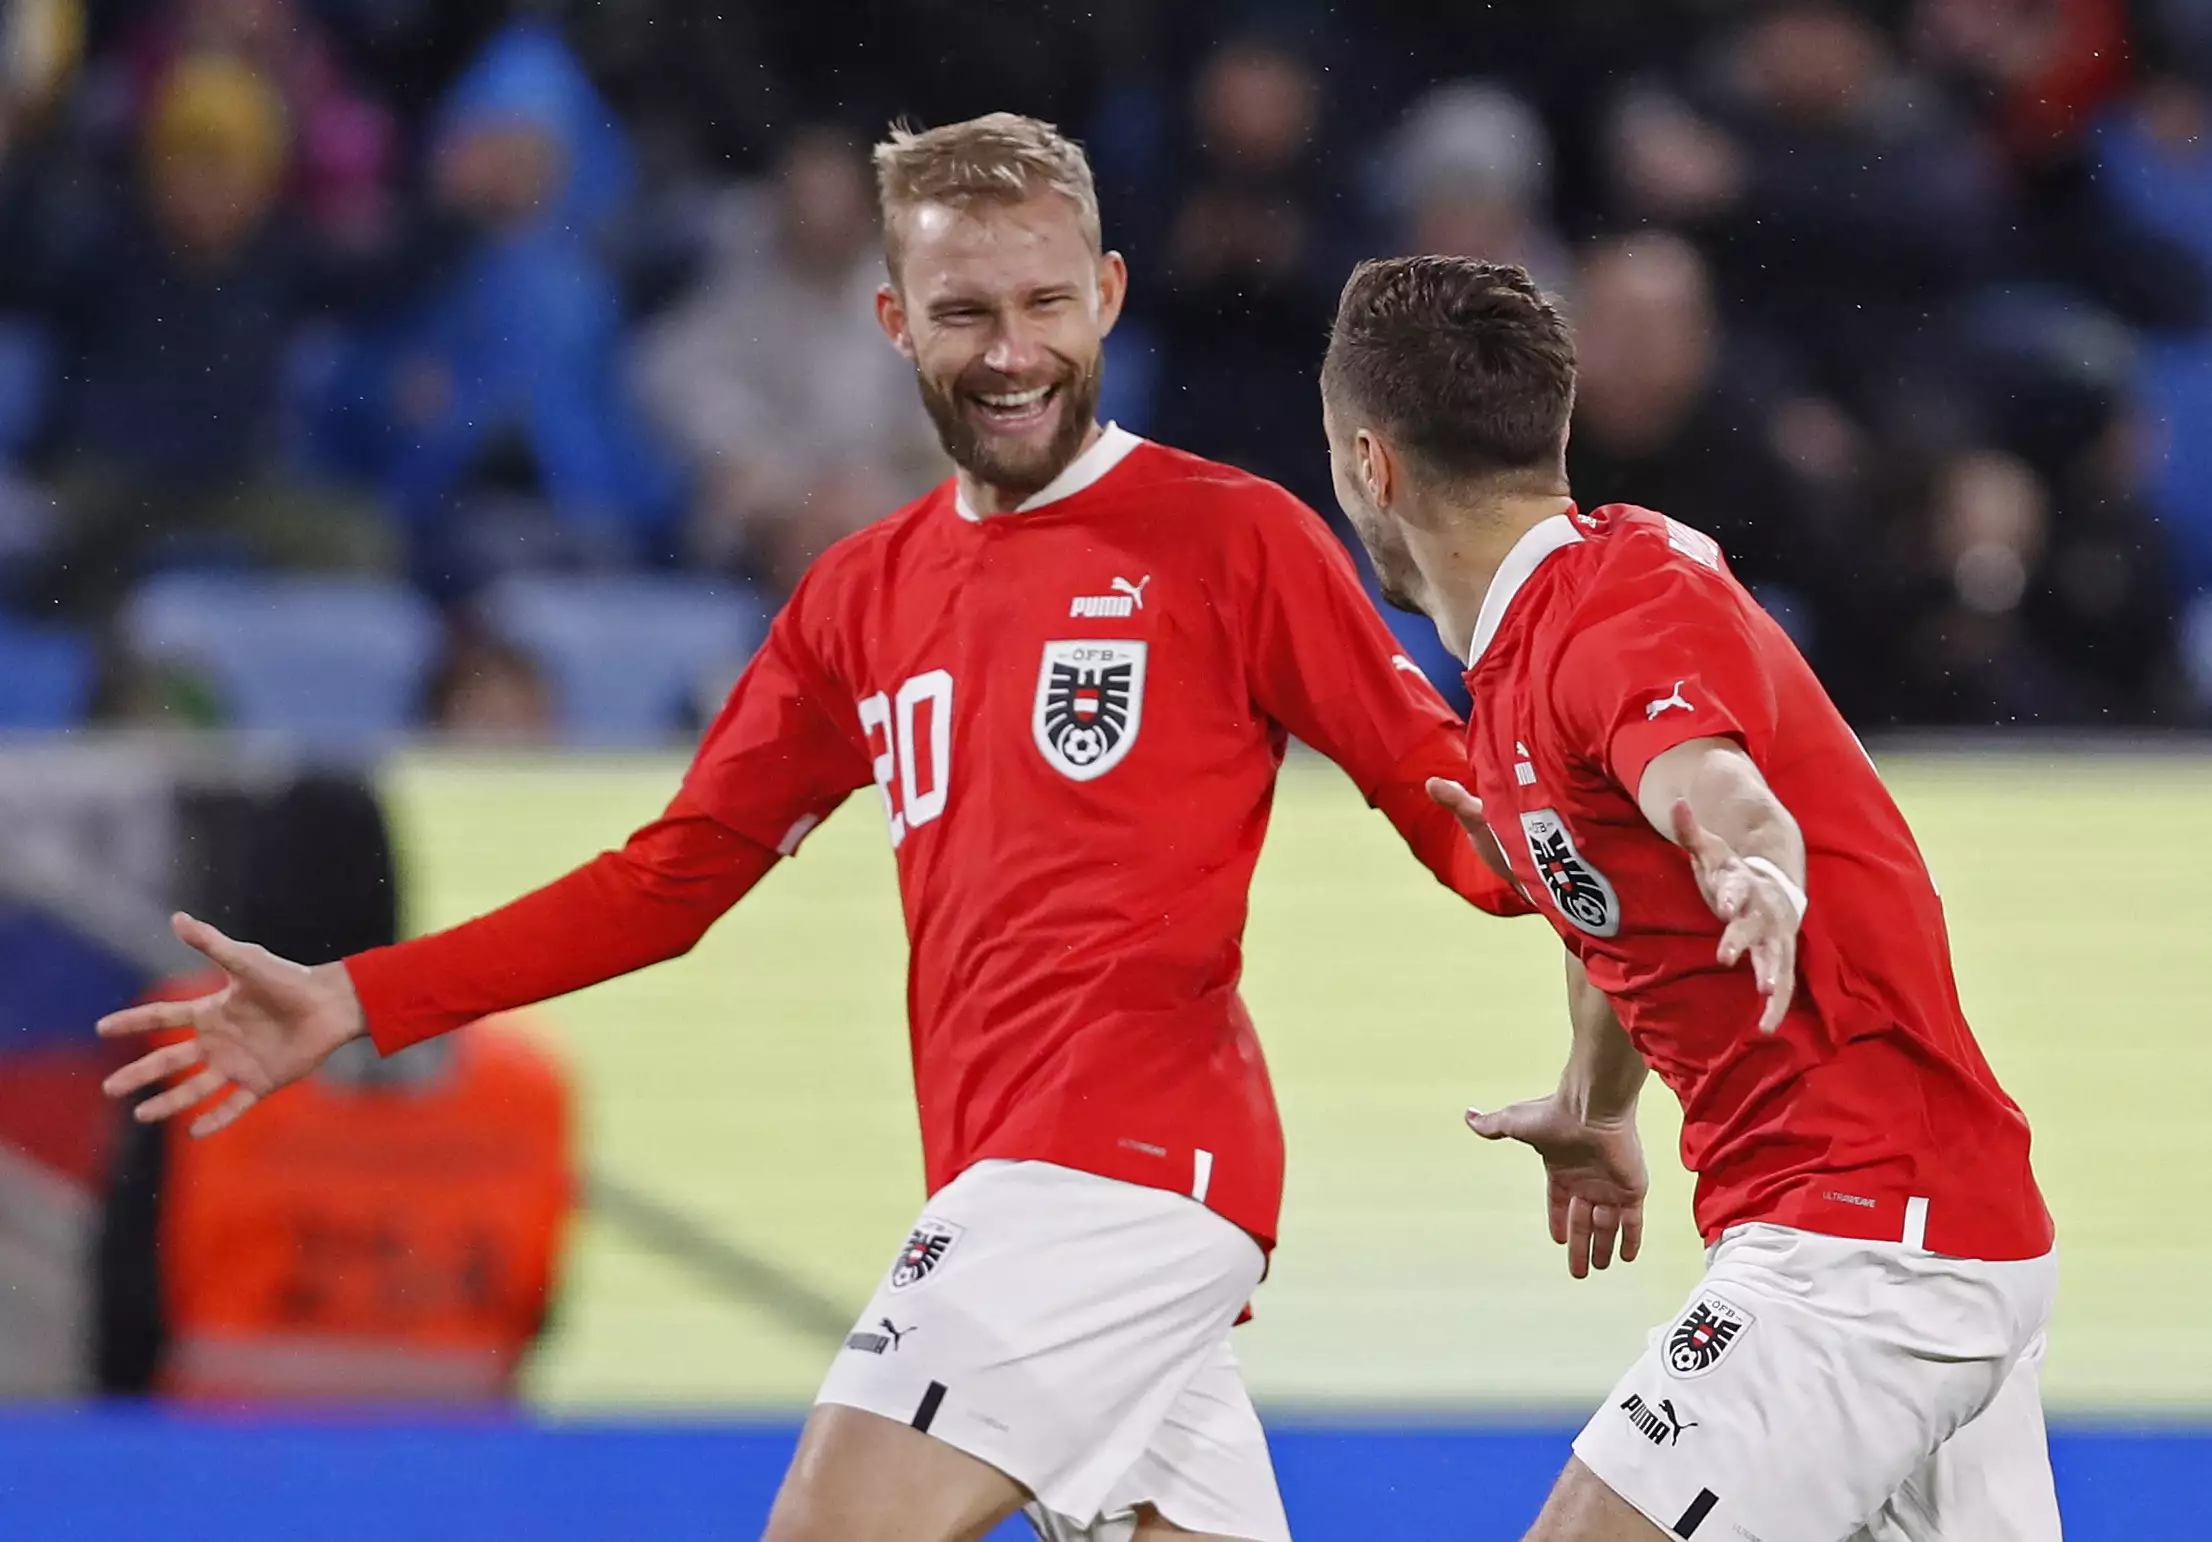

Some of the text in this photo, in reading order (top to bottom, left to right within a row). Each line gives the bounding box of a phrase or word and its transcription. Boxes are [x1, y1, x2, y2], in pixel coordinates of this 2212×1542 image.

[1069, 596, 1133, 618] PUMA
[858, 669, 954, 849] 20
[1620, 1393, 1671, 1445] PUMA
